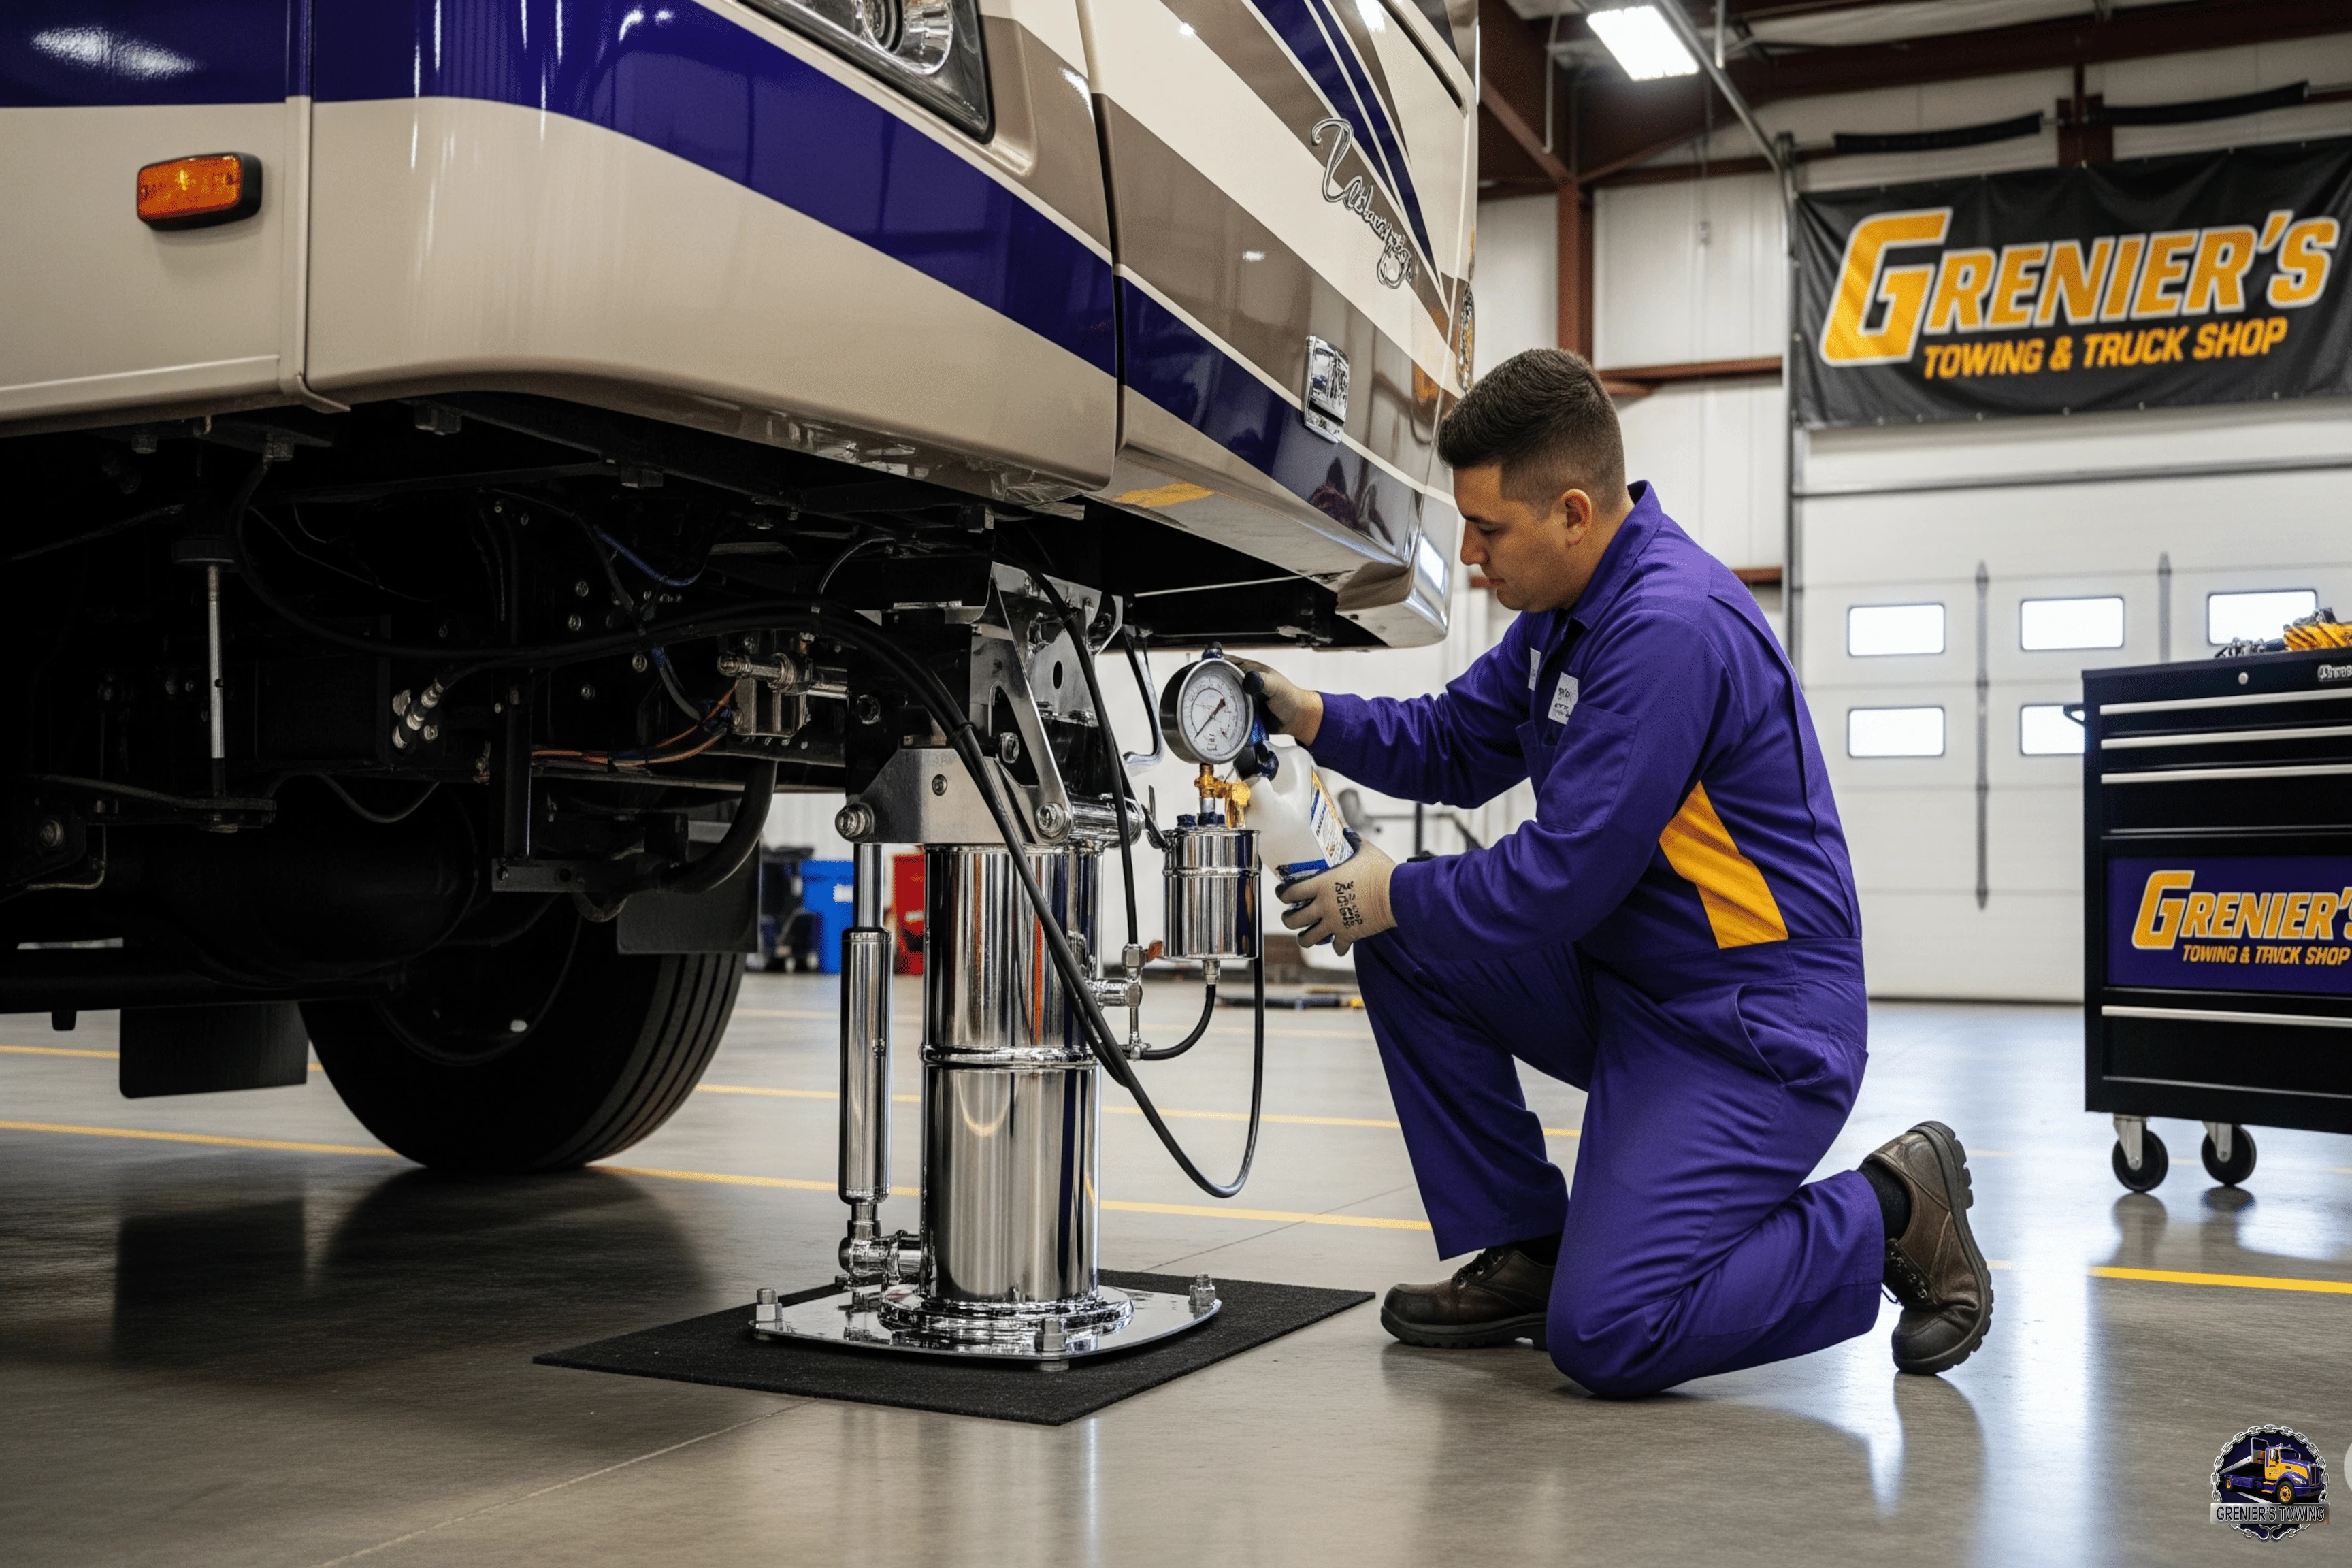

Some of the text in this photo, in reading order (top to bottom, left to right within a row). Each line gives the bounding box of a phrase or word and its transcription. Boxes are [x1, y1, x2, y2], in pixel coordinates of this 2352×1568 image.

[1819, 208, 2340, 367] GRENIER'S
[1923, 317, 2289, 380] TOWING & TRUCK SHOP
[2132, 870, 2352, 949] GRENIER'
[2183, 944, 2238, 964] TOWING
[2239, 945, 2251, 964] &
[2304, 946, 2351, 966] SHOP
